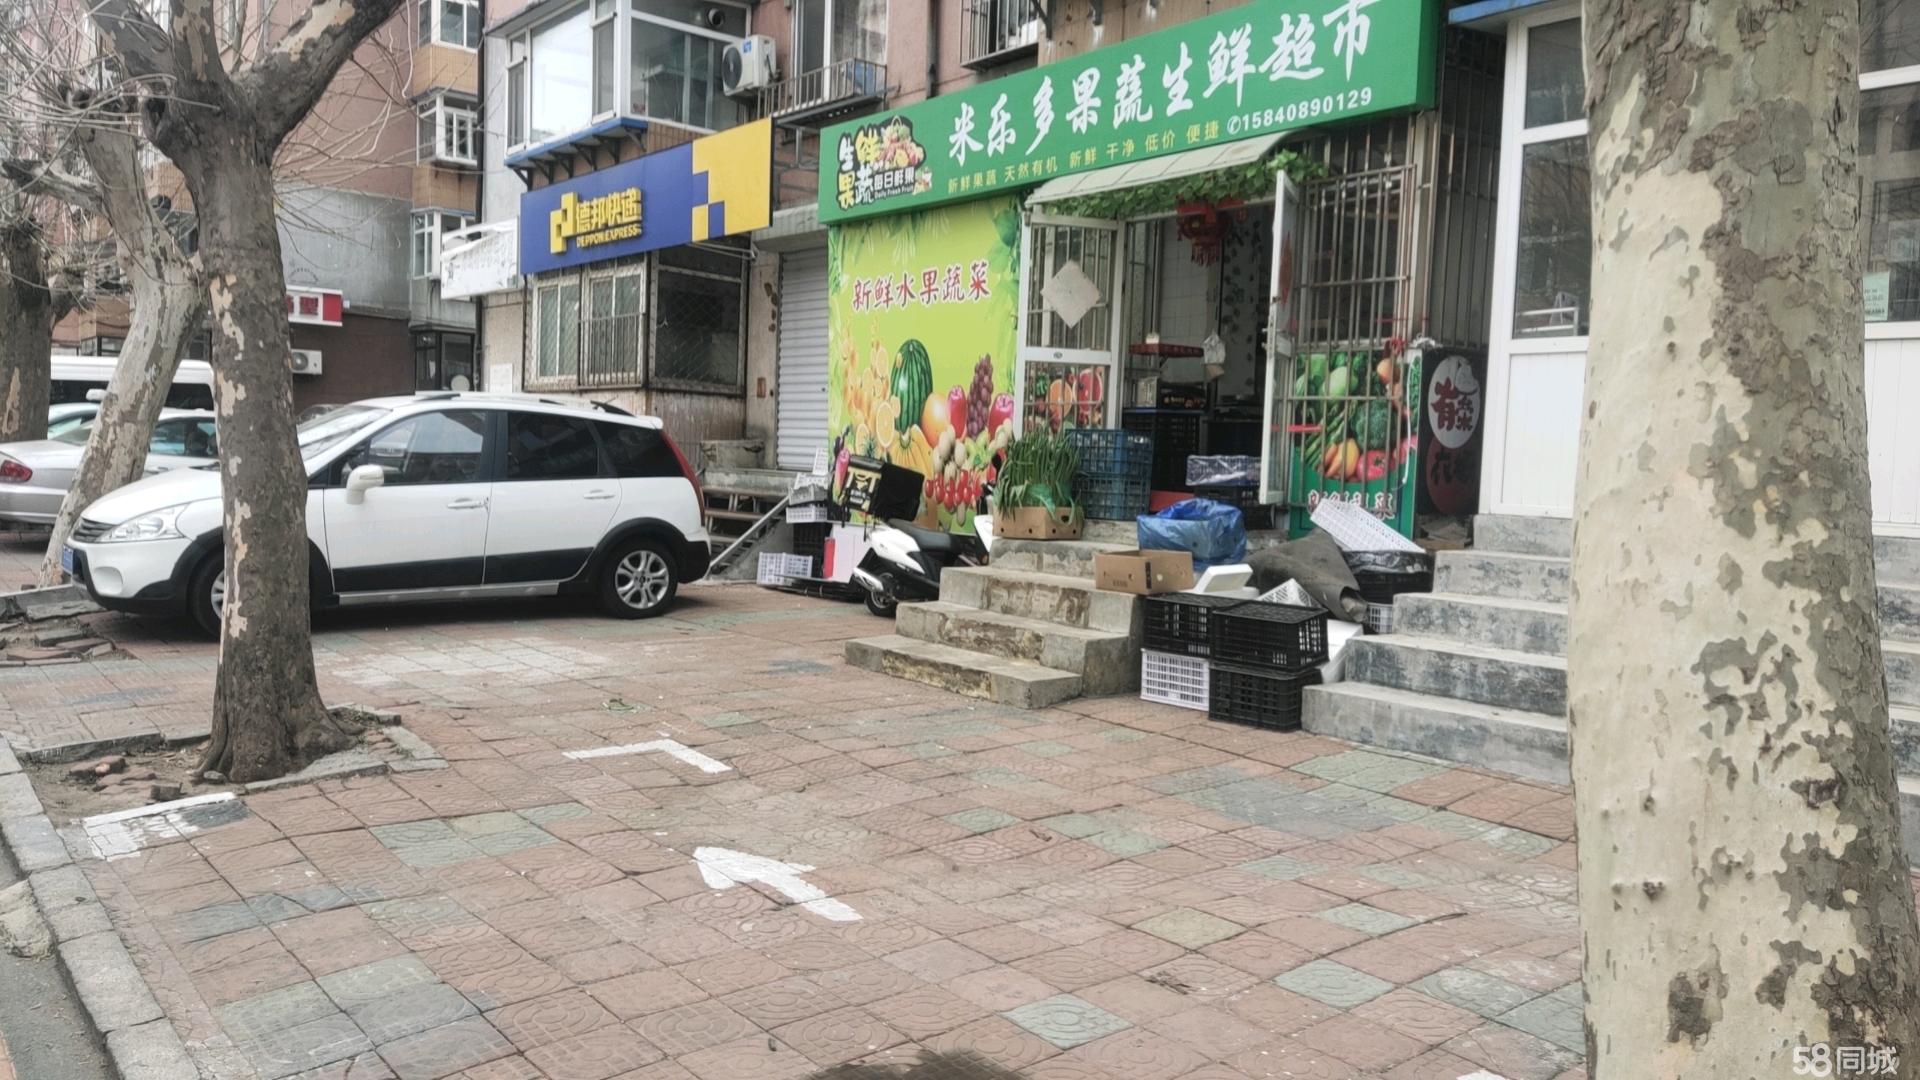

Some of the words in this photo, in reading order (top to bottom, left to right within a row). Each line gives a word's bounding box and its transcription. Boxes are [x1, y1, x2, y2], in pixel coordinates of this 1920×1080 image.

[949, 0, 1382, 167] 米乐多果蔬生鲜超市
[1241, 87, 1372, 131] 15840890129
[948, 169, 997, 194] 新鲜果蔬
[1004, 157, 1058, 182] 天然有机
[1069, 146, 1097, 169] 新鲜
[1106, 138, 1135, 160] 干净
[1145, 129, 1176, 153] 低价
[1186, 119, 1220, 144] 便捷
[576, 187, 641, 234] 德邦快递
[605, 224, 641, 242] EXPRESS
[852, 258, 992, 313] 新鲜水果蔬菜
